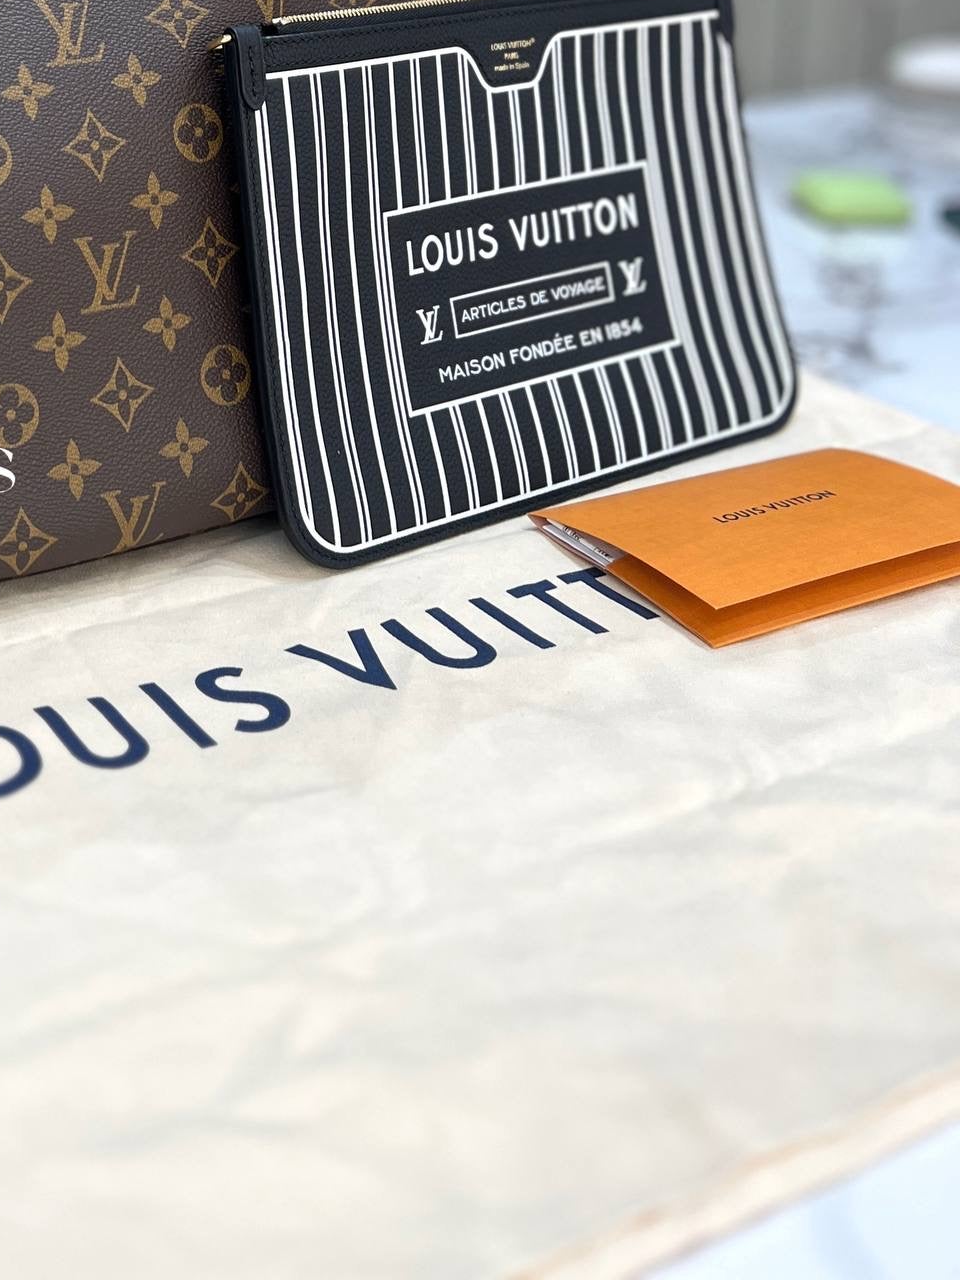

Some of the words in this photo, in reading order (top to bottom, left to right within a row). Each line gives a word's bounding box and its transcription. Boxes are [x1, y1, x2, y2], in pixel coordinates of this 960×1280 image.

[406, 222, 499, 276] LOUIS
[508, 193, 640, 252] VUITTON
[461, 296, 527, 323] ARTICLES
[530, 290, 548, 306] DE
[550, 276, 605, 301] VOYAGE
[438, 351, 506, 384] MAISON
[509, 332, 577, 365] FONDÉE
[579, 327, 603, 348] EN
[605, 317, 643, 341] 1854
[712, 507, 766, 523] LOUIS
[762, 490, 837, 510] VUITTON
[284, 566, 661, 690] VUITT
